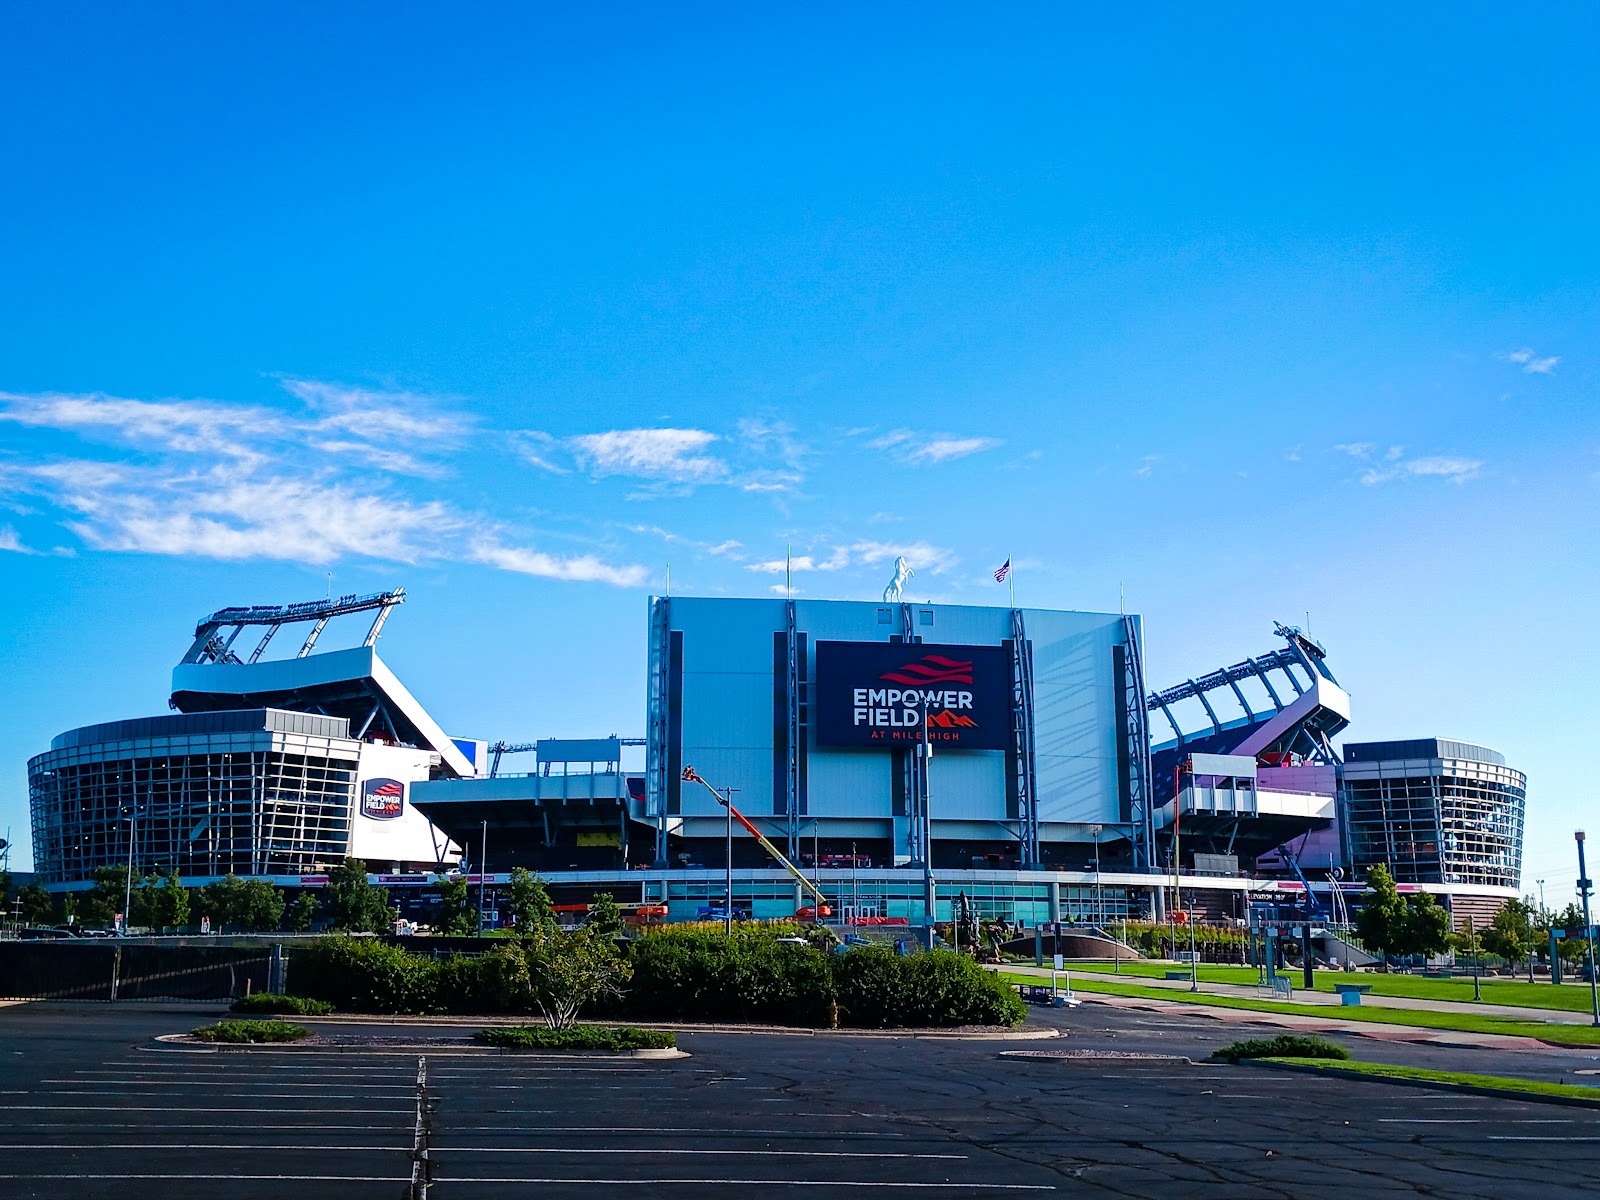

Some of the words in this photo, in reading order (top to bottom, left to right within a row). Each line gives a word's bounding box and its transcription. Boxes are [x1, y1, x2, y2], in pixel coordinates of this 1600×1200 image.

[853, 688, 973, 709] EMPOWER
[854, 707, 920, 727] FIELD
[871, 731, 885, 739] AT
[892, 731, 922, 740] MILE
[929, 732, 960, 740] HIGH
[366, 794, 400, 804] EMPOWER
[366, 802, 385, 810] FIELD
